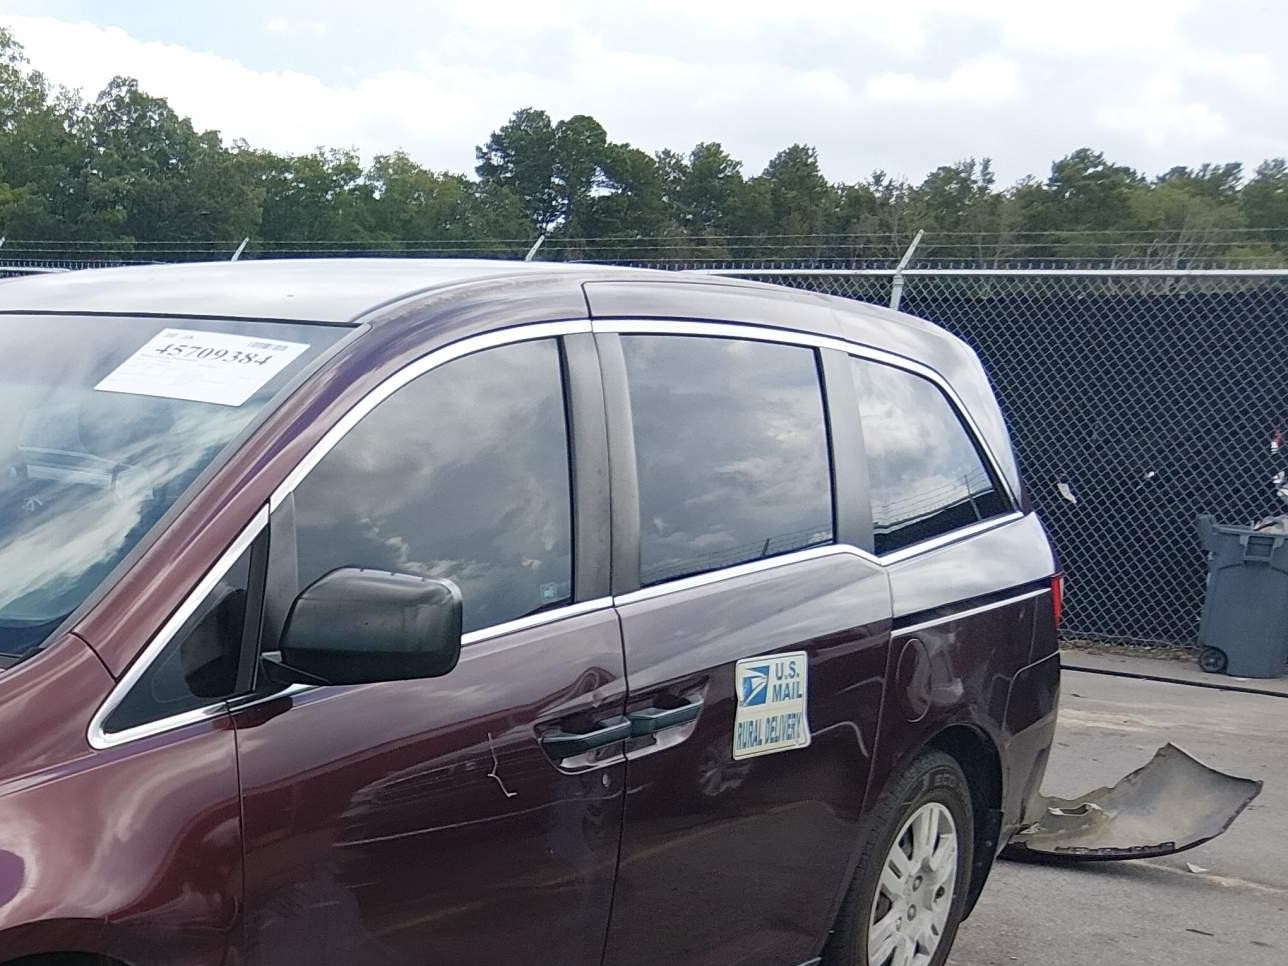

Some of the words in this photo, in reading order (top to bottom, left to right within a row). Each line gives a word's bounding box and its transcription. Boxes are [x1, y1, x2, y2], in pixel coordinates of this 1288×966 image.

[155, 343, 273, 367] 45709384
[775, 661, 800, 681] U.S.
[772, 682, 803, 702] MAIL
[736, 718, 763, 750] RURAL
[764, 712, 803, 744] DELIVERY
